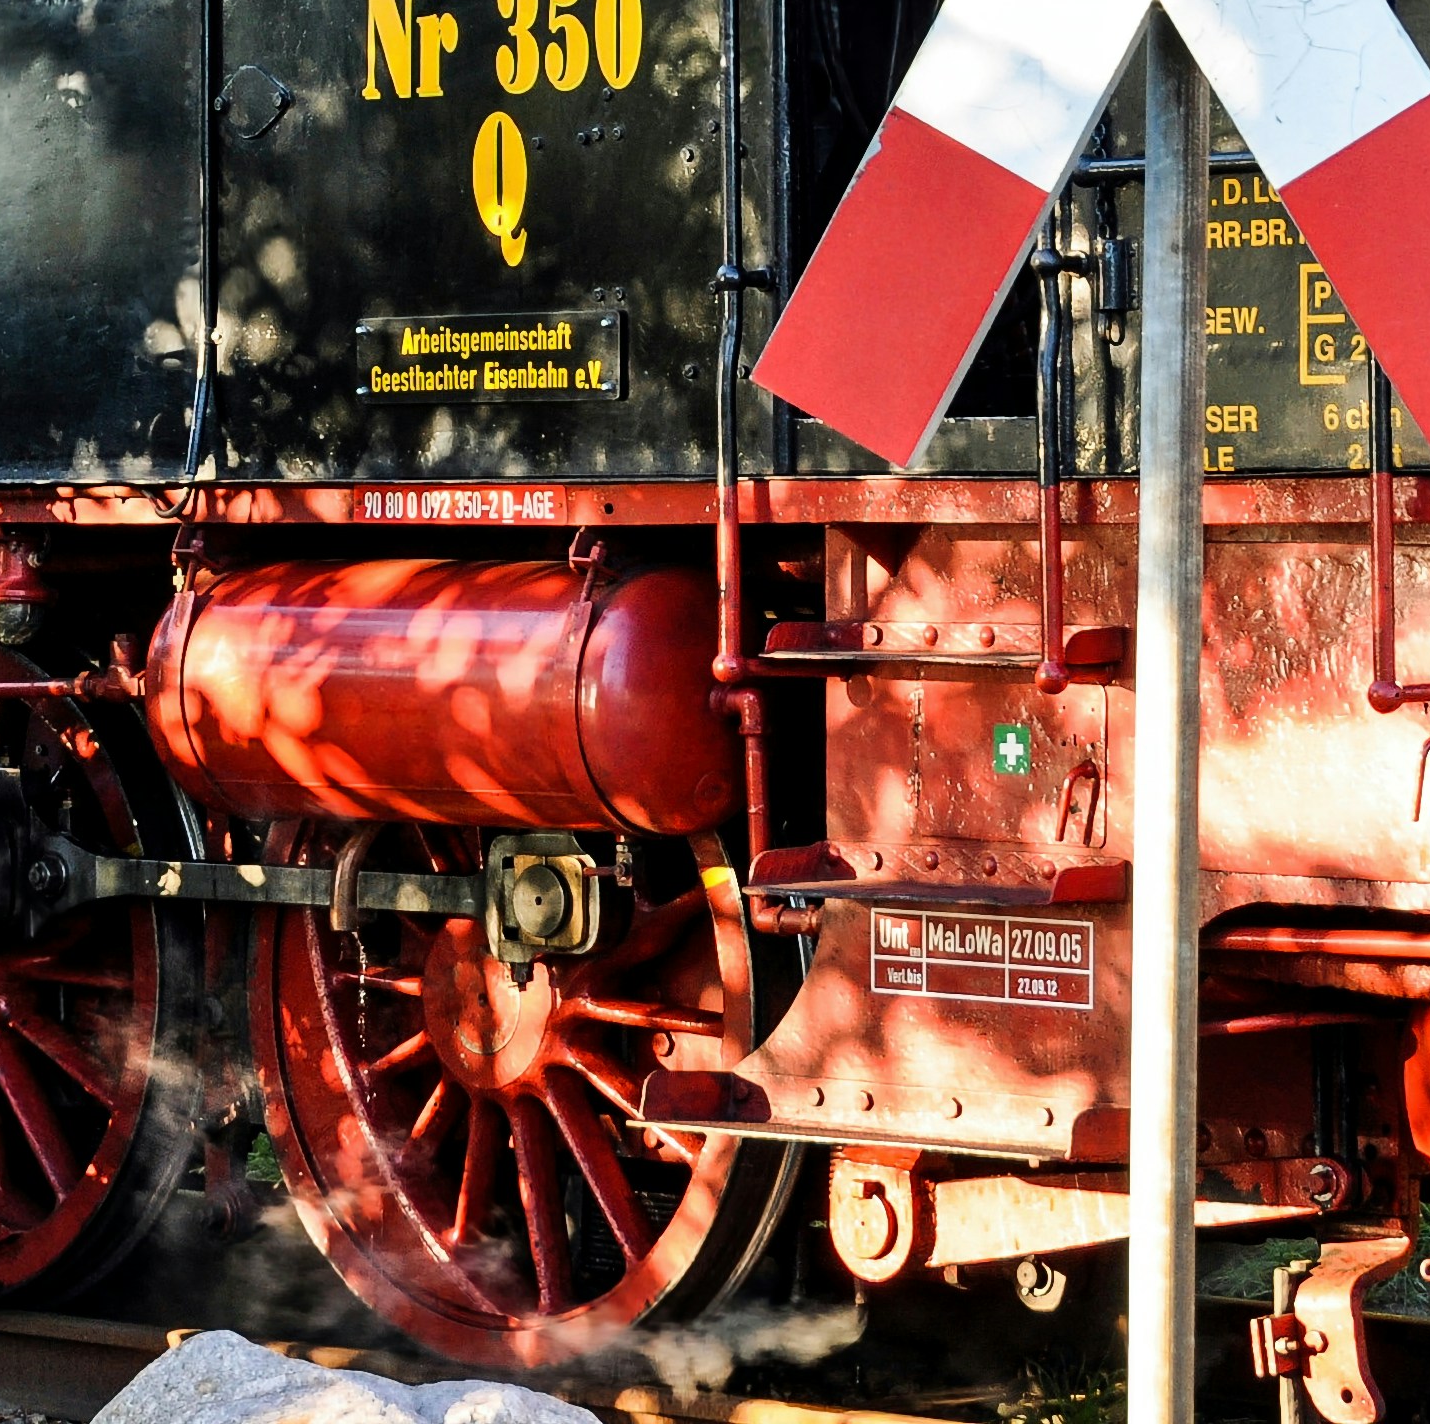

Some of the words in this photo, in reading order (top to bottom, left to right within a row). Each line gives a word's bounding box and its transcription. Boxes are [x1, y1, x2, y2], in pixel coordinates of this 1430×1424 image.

[473, 111, 527, 267] Q
[1206, 218, 1293, 249] RR-BR.
[1314, 280, 1332, 308] P
[400, 321, 572, 359] Arbeitsgemeinschaft
[1314, 333, 1335, 361] G
[371, 364, 477, 393] Geesthachter
[483, 360, 568, 390] Eisenbahn
[575, 360, 602, 389] e.V.
[1205, 405, 1258, 433] SER
[1323, 403, 1340, 430] 6
[364, 491, 381, 518] 90
[385, 491, 403, 518] 80
[407, 491, 417, 518] 0
[422, 491, 451, 518] 092
[454, 491, 499, 519] 350-2
[502, 491, 555, 523] D-AGE
[879, 918, 909, 949] Unt
[928, 922, 1002, 956] MaLoWa
[1011, 928, 1082, 964] 27.09.05
